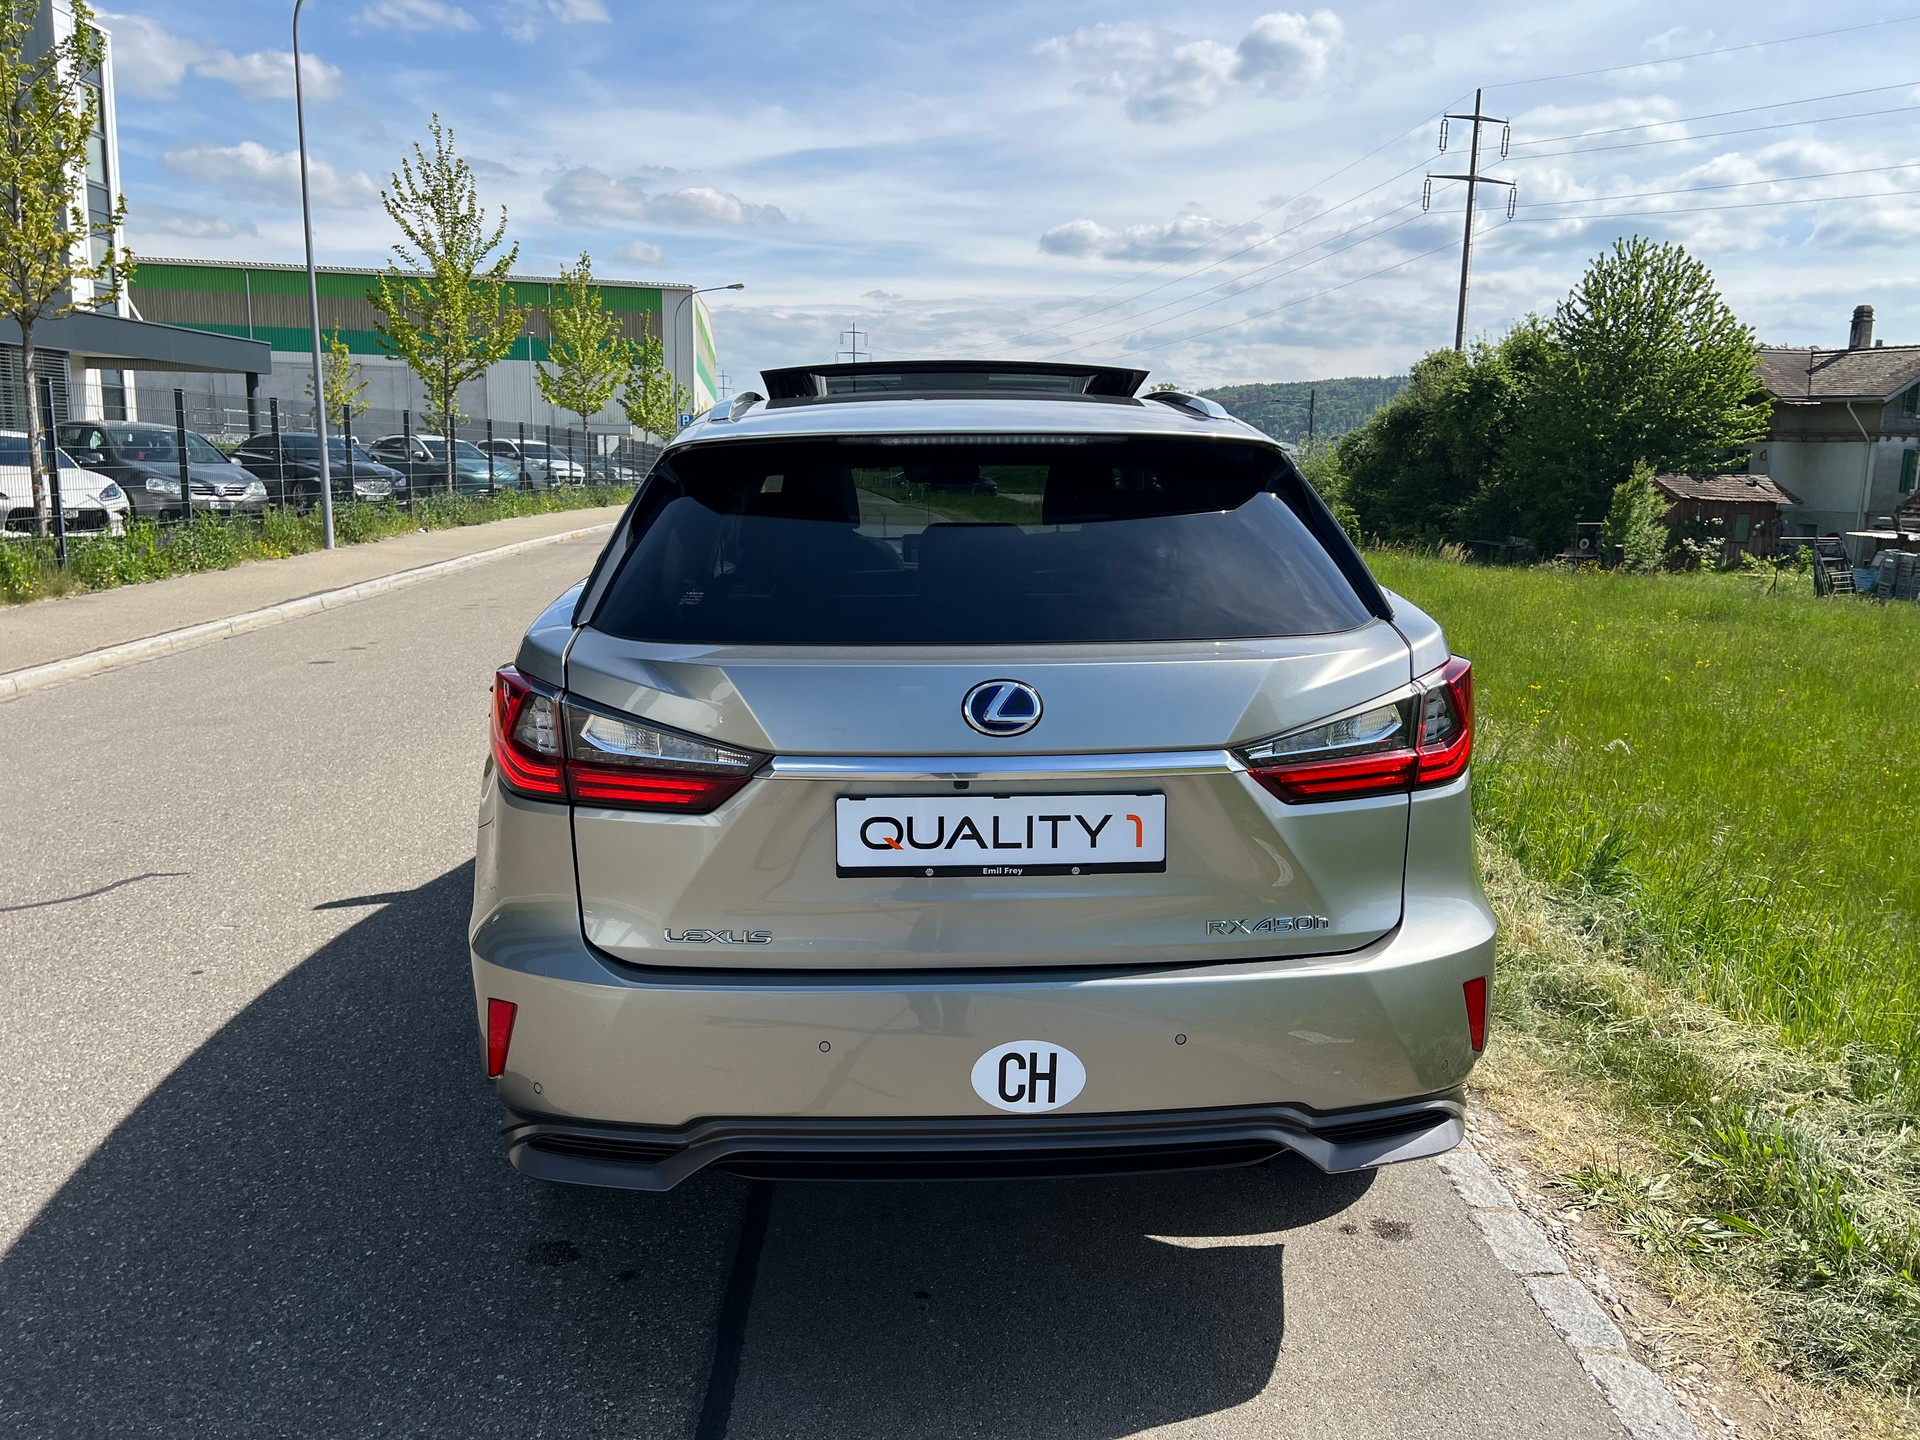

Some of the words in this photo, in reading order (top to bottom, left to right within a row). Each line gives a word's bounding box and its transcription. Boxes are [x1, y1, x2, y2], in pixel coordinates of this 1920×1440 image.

[682, 415, 690, 425] P
[860, 814, 1113, 850] QUALITY
[1126, 814, 1143, 848] 1
[982, 867, 1002, 875] Emil
[1004, 867, 1023, 875] Frey
[1206, 919, 1251, 935] RX
[1252, 915, 1329, 933] 450h
[664, 928, 772, 945] LEXUS
[998, 1052, 1058, 1103] CH
